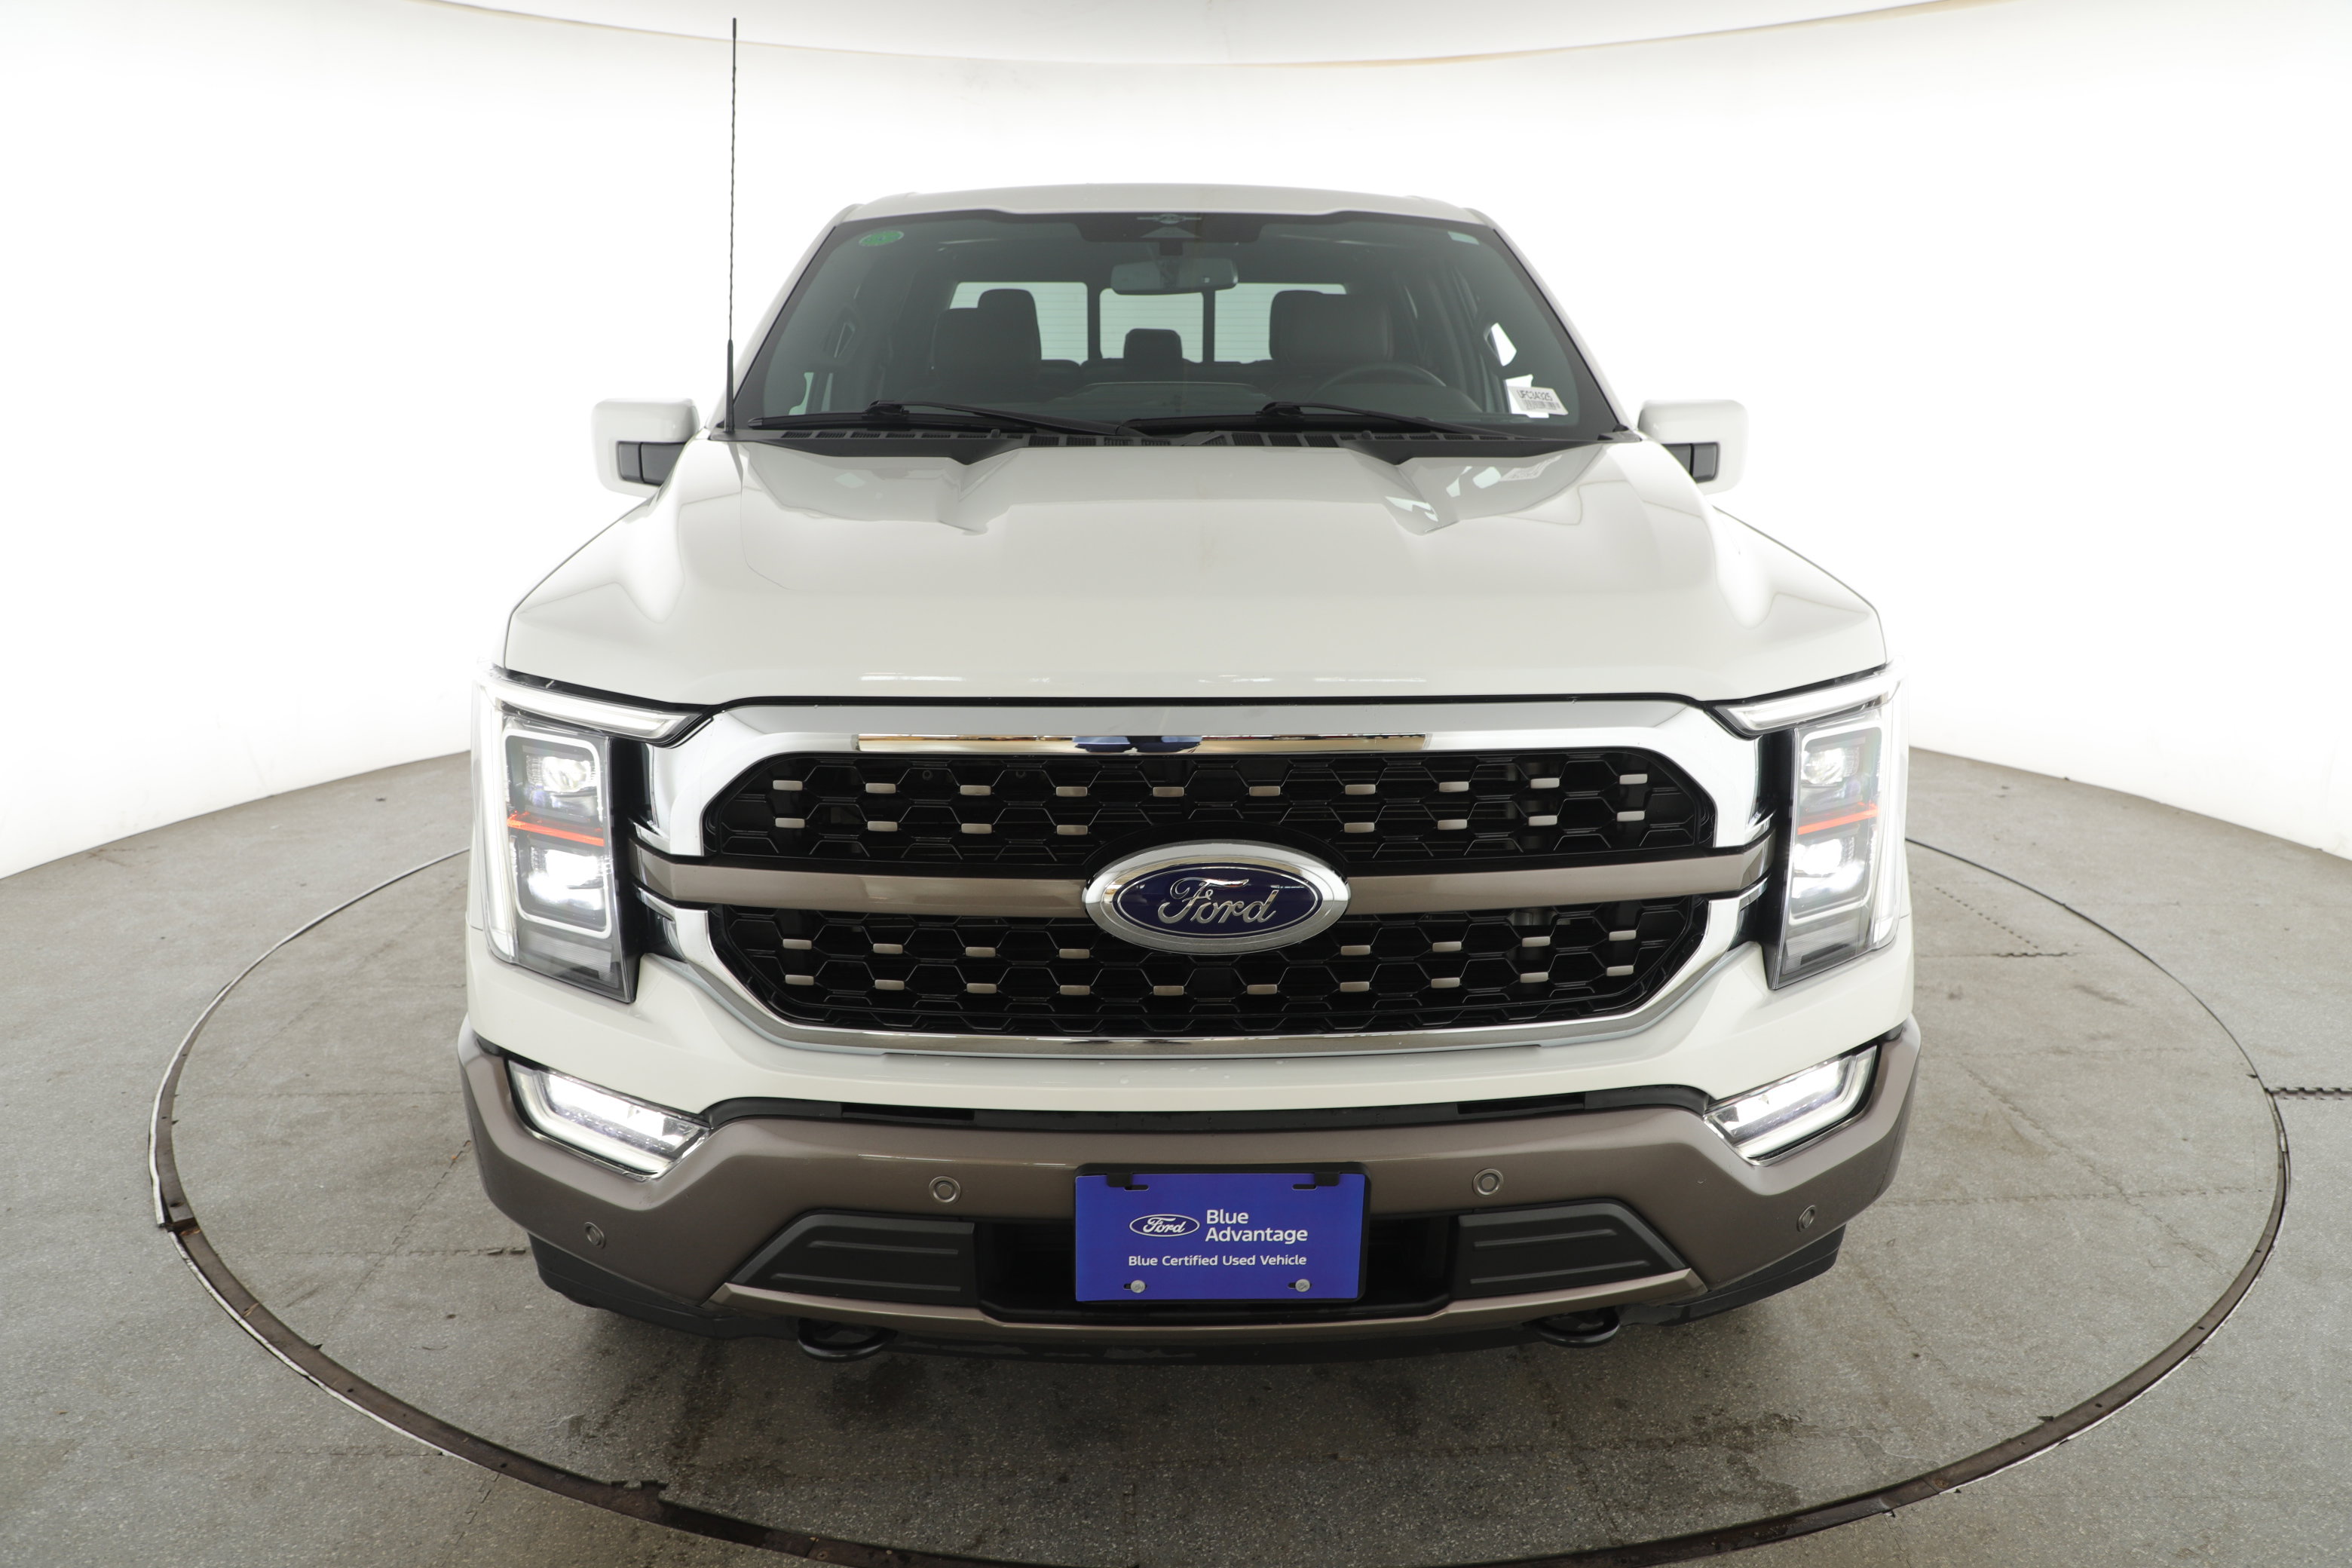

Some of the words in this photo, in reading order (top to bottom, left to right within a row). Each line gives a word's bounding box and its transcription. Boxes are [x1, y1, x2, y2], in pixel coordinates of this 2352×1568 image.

[1157, 877, 1280, 924] Ford
[1142, 1217, 1186, 1233] Ford
[1206, 1208, 1249, 1225] Blue
[1205, 1227, 1308, 1244] Advantage
[1129, 1256, 1158, 1266] Blue
[1162, 1254, 1218, 1266] Certified
[1222, 1254, 1256, 1266] Used
[1260, 1254, 1307, 1266] Vehicle
